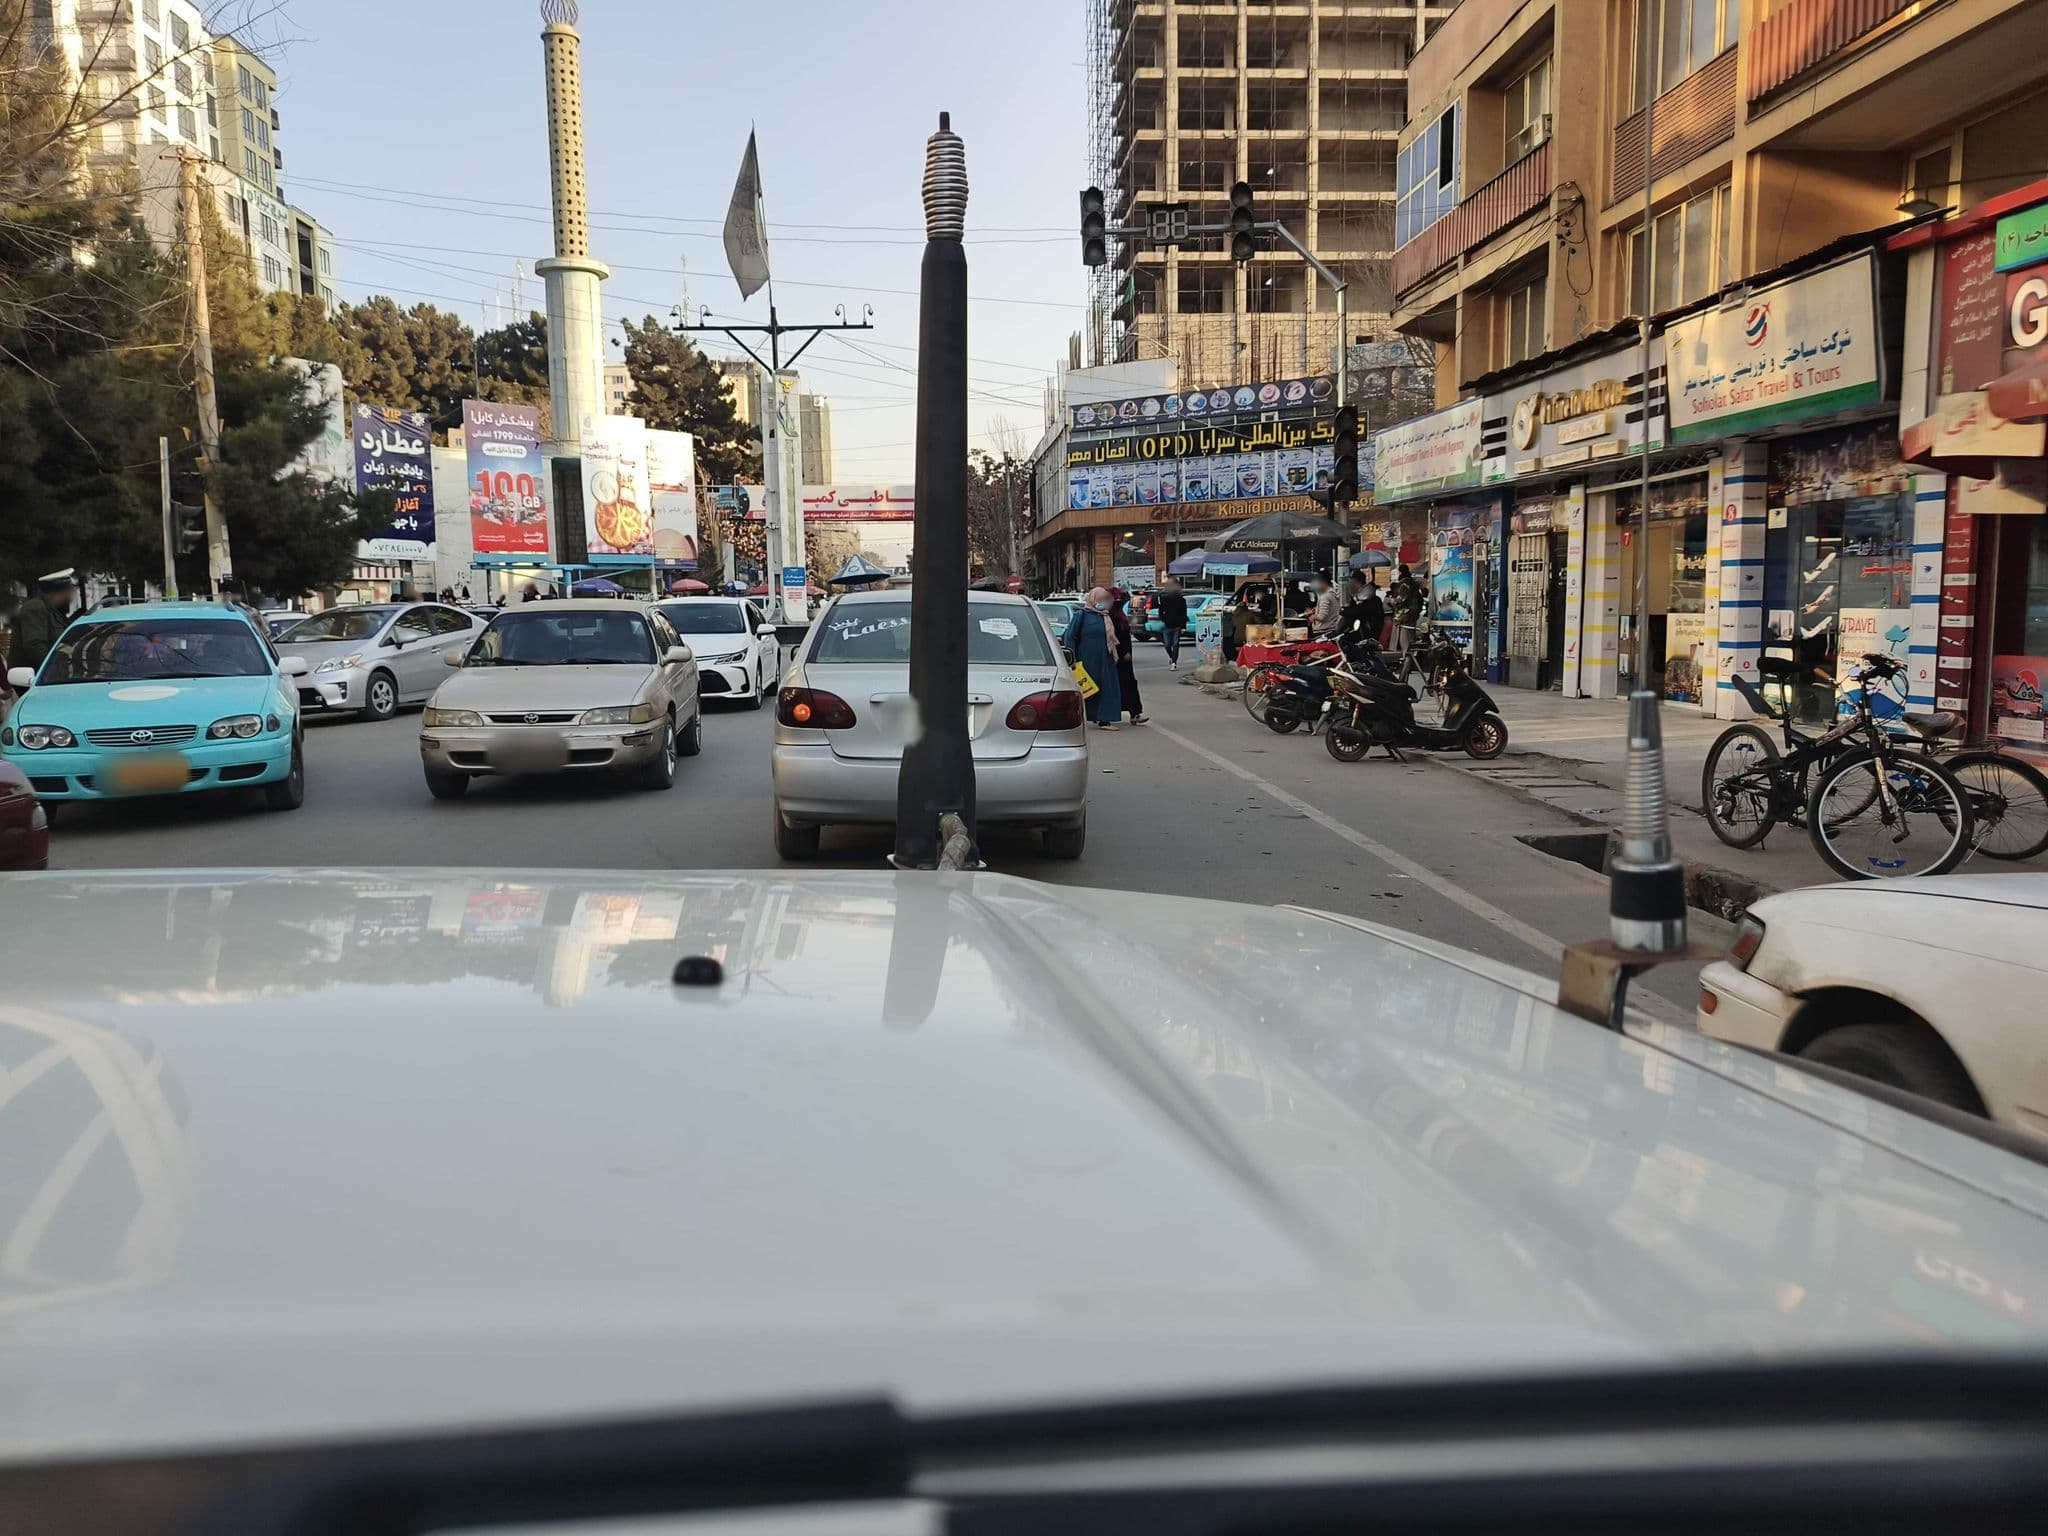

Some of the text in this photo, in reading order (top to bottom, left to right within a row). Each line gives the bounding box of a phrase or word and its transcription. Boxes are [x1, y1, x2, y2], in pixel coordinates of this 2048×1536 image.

[1820, 328, 1851, 355] شرکت
[1730, 386, 1754, 405] Safar
[1757, 378, 1789, 398] Travel
[1793, 372, 1803, 389] &
[1807, 366, 1840, 387] Tours
[495, 413, 534, 431] پیشکش
[361, 429, 425, 457] عطارد
[493, 430, 513, 440] 1799
[1136, 433, 1193, 459] (OPD)
[1200, 429, 1235, 457] سراپا
[363, 460, 386, 475] زبان
[523, 495, 540, 508] GB
[1219, 501, 1260, 516] Khalid
[1263, 499, 1300, 513] Dubai
